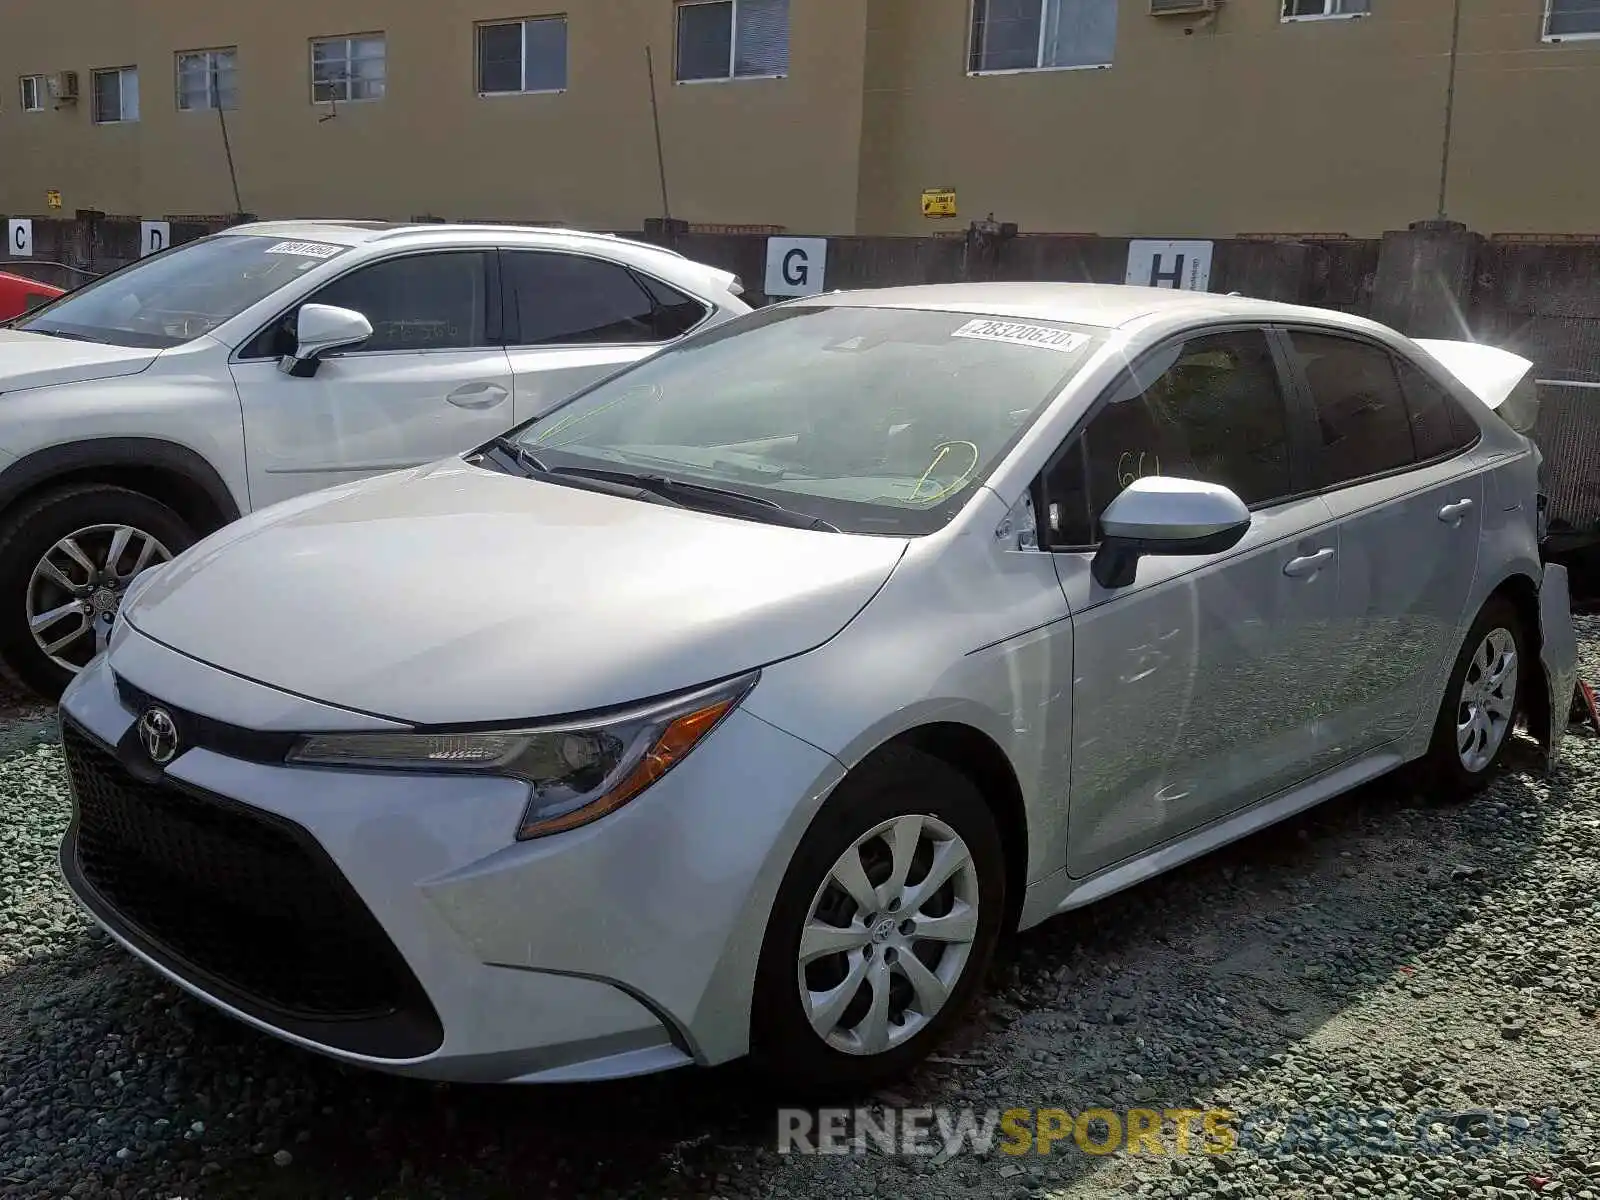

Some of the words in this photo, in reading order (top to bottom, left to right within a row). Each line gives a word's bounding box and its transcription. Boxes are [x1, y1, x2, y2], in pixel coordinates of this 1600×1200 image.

[15, 226, 26, 249] C
[150, 229, 162, 250] D
[782, 248, 809, 286] G
[1150, 253, 1185, 289] H
[970, 321, 1072, 345] 28320620
